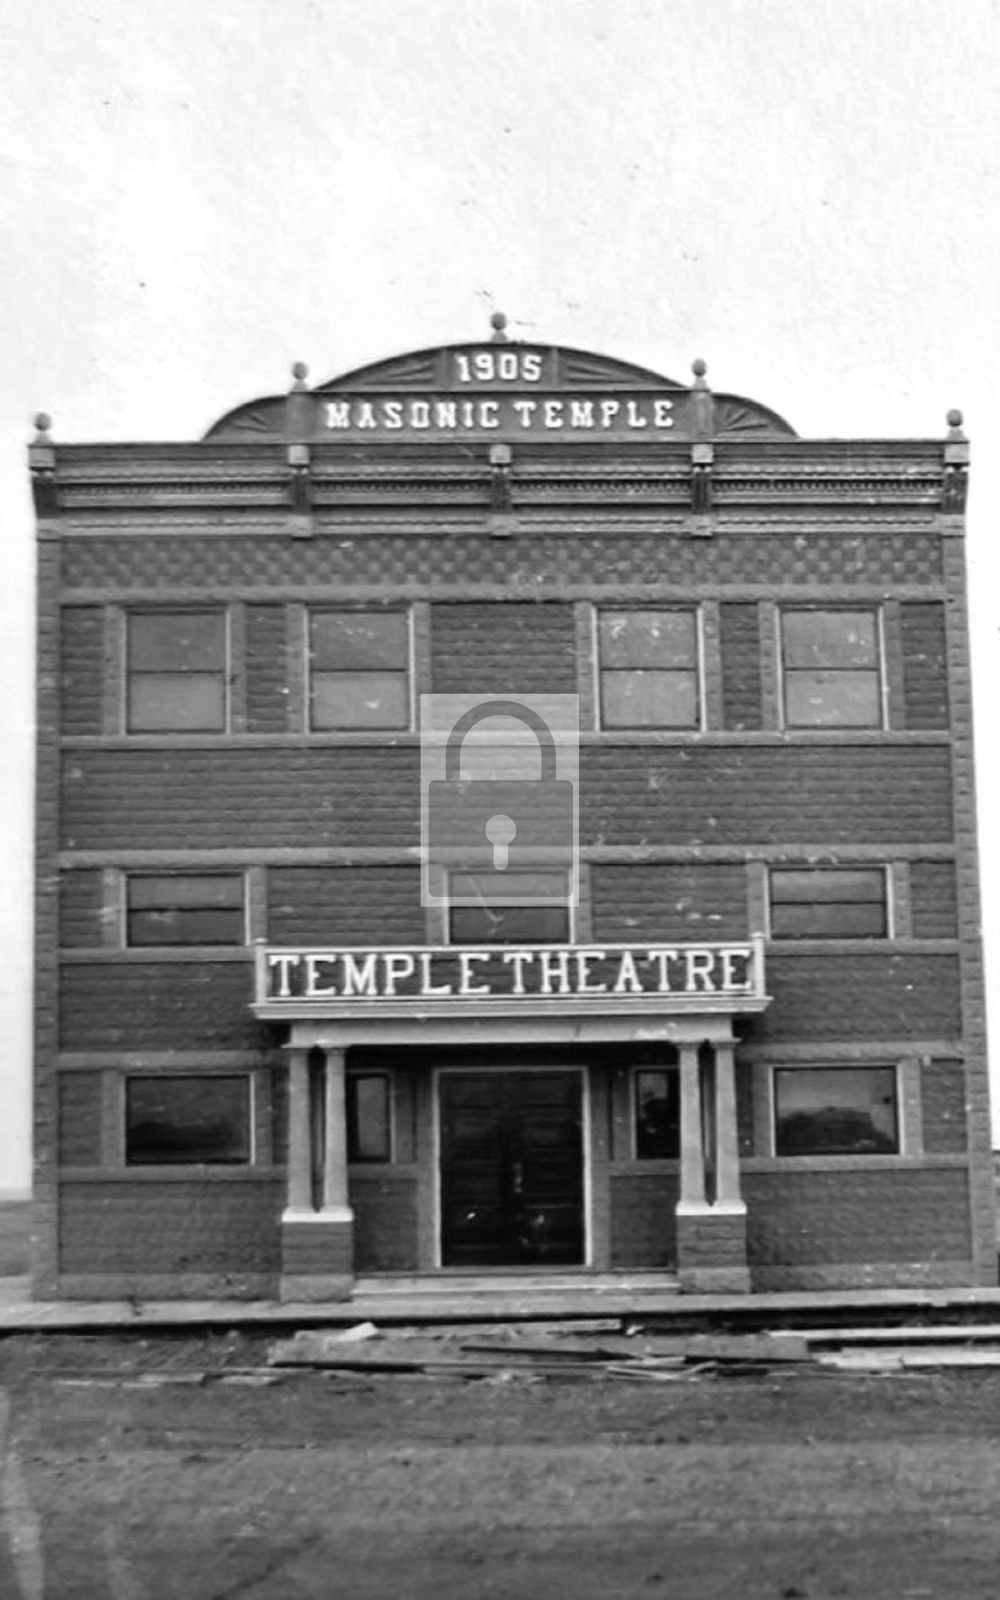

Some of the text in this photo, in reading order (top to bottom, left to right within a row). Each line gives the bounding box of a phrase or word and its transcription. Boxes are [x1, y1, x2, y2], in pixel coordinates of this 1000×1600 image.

[456, 353, 543, 382] 1905
[325, 400, 675, 429] MASONIC TEMPLE
[269, 949, 753, 997] TEMPLE THEATRE
